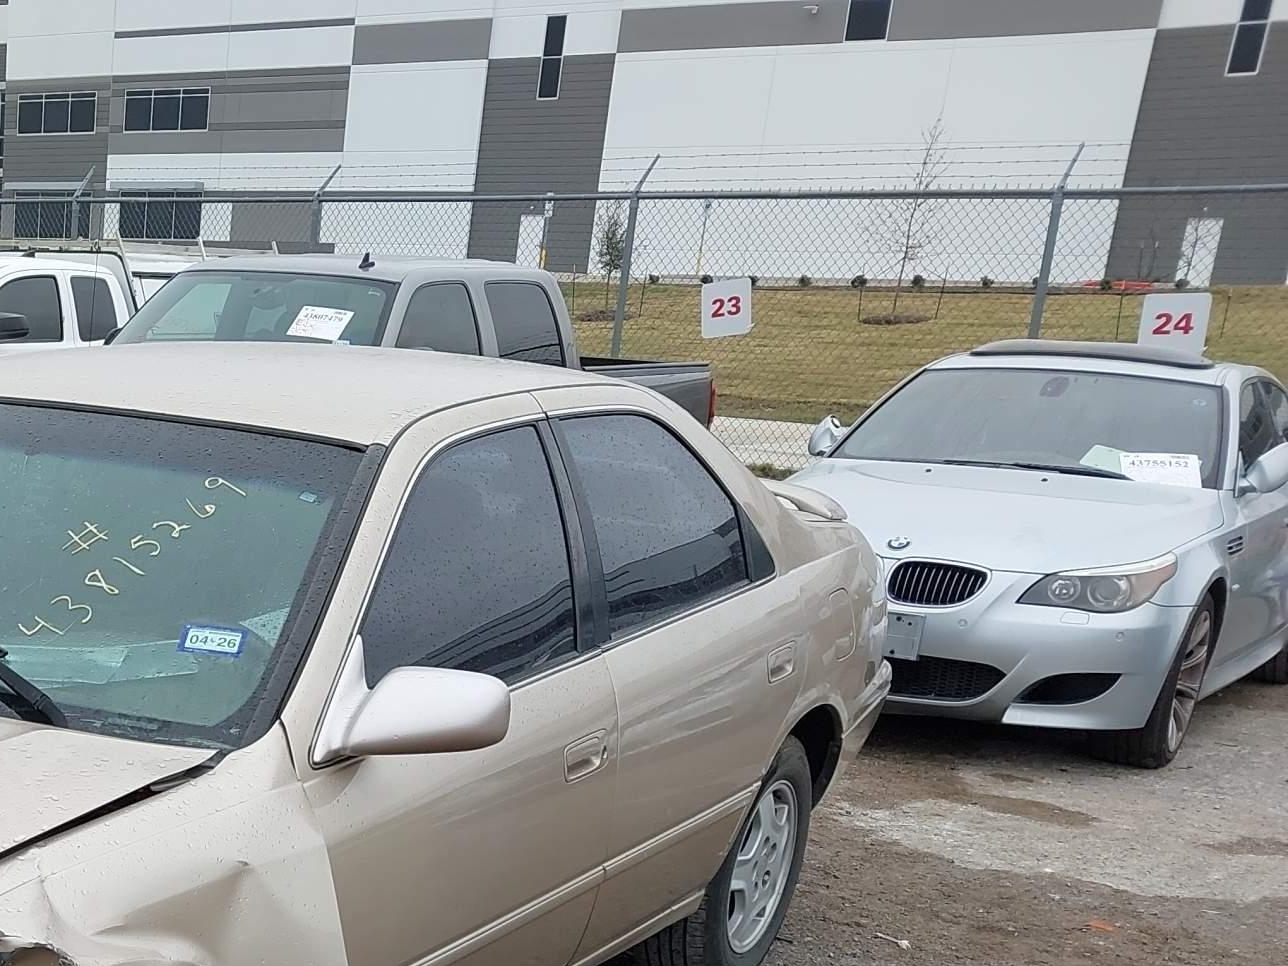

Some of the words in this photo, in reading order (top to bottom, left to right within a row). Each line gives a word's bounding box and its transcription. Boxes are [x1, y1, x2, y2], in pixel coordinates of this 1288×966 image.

[711, 296, 741, 318] 23
[1152, 312, 1194, 335] 24
[18, 477, 247, 636] 43815269
